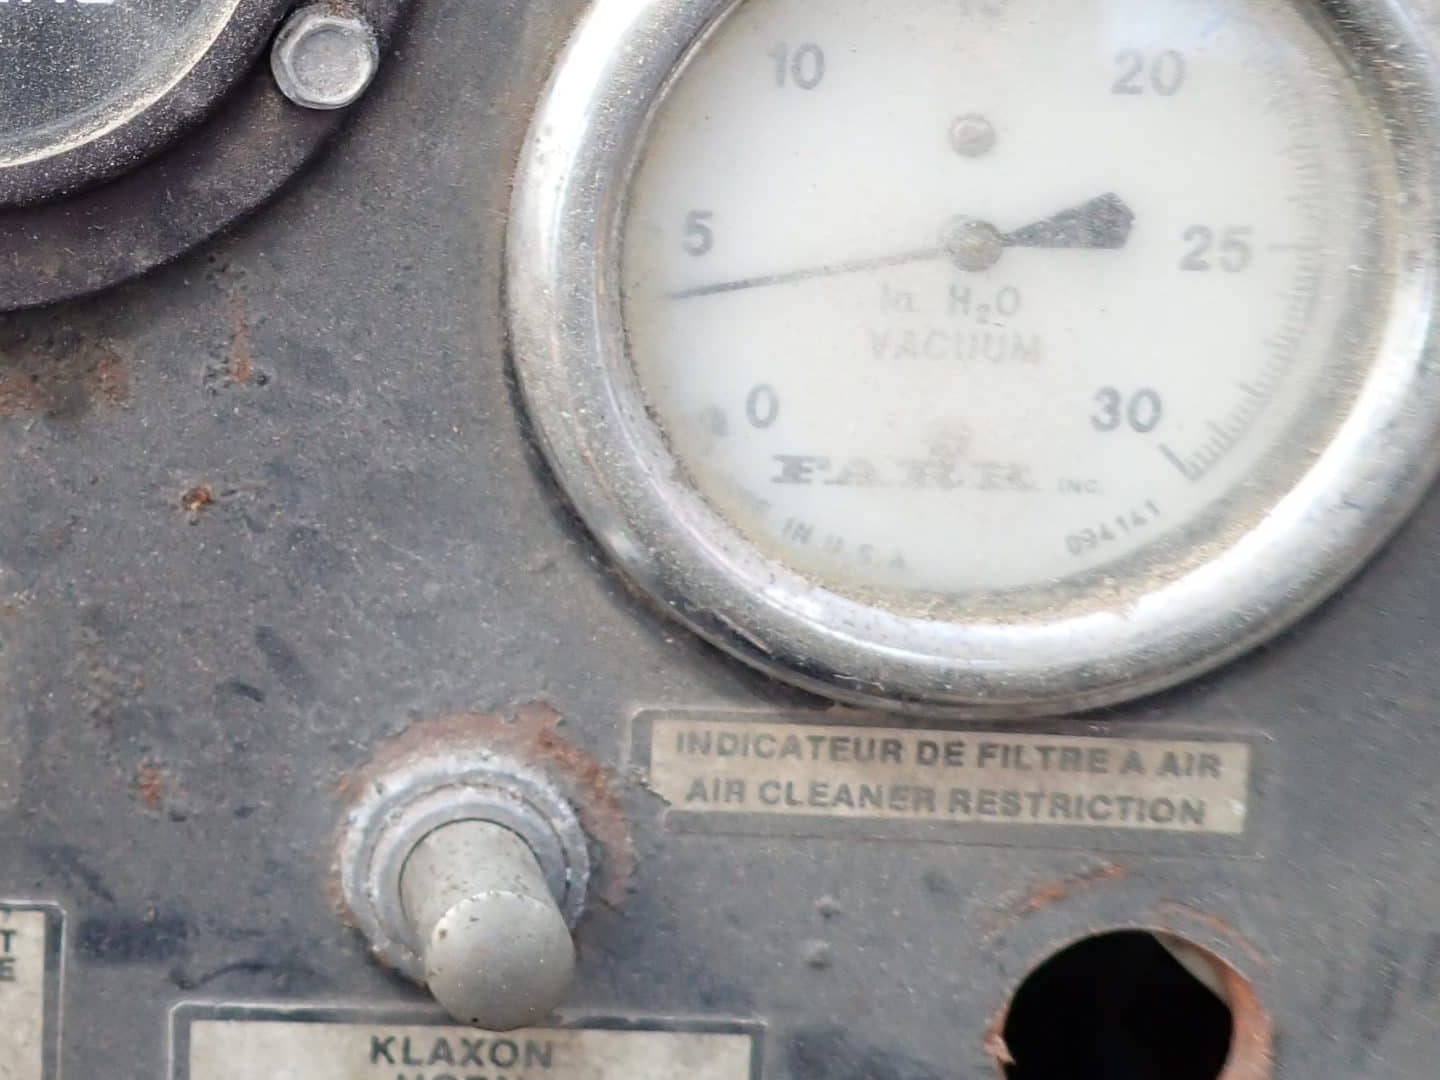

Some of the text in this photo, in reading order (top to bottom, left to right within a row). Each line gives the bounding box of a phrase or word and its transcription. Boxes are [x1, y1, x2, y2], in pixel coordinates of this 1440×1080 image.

[769, 42, 826, 91] 10
[1112, 47, 1187, 97] 20
[681, 210, 715, 258] 5
[1178, 225, 1254, 274] 25
[871, 329, 1043, 364] VACUUM
[744, 383, 781, 430] 0
[1089, 387, 1164, 434] 30
[675, 729, 1223, 779] INDICATEUR DE FILTRE A AIR
[685, 776, 1208, 826] AIR CLEANER RESTRICTION
[369, 1034, 554, 1069] KLAXON
